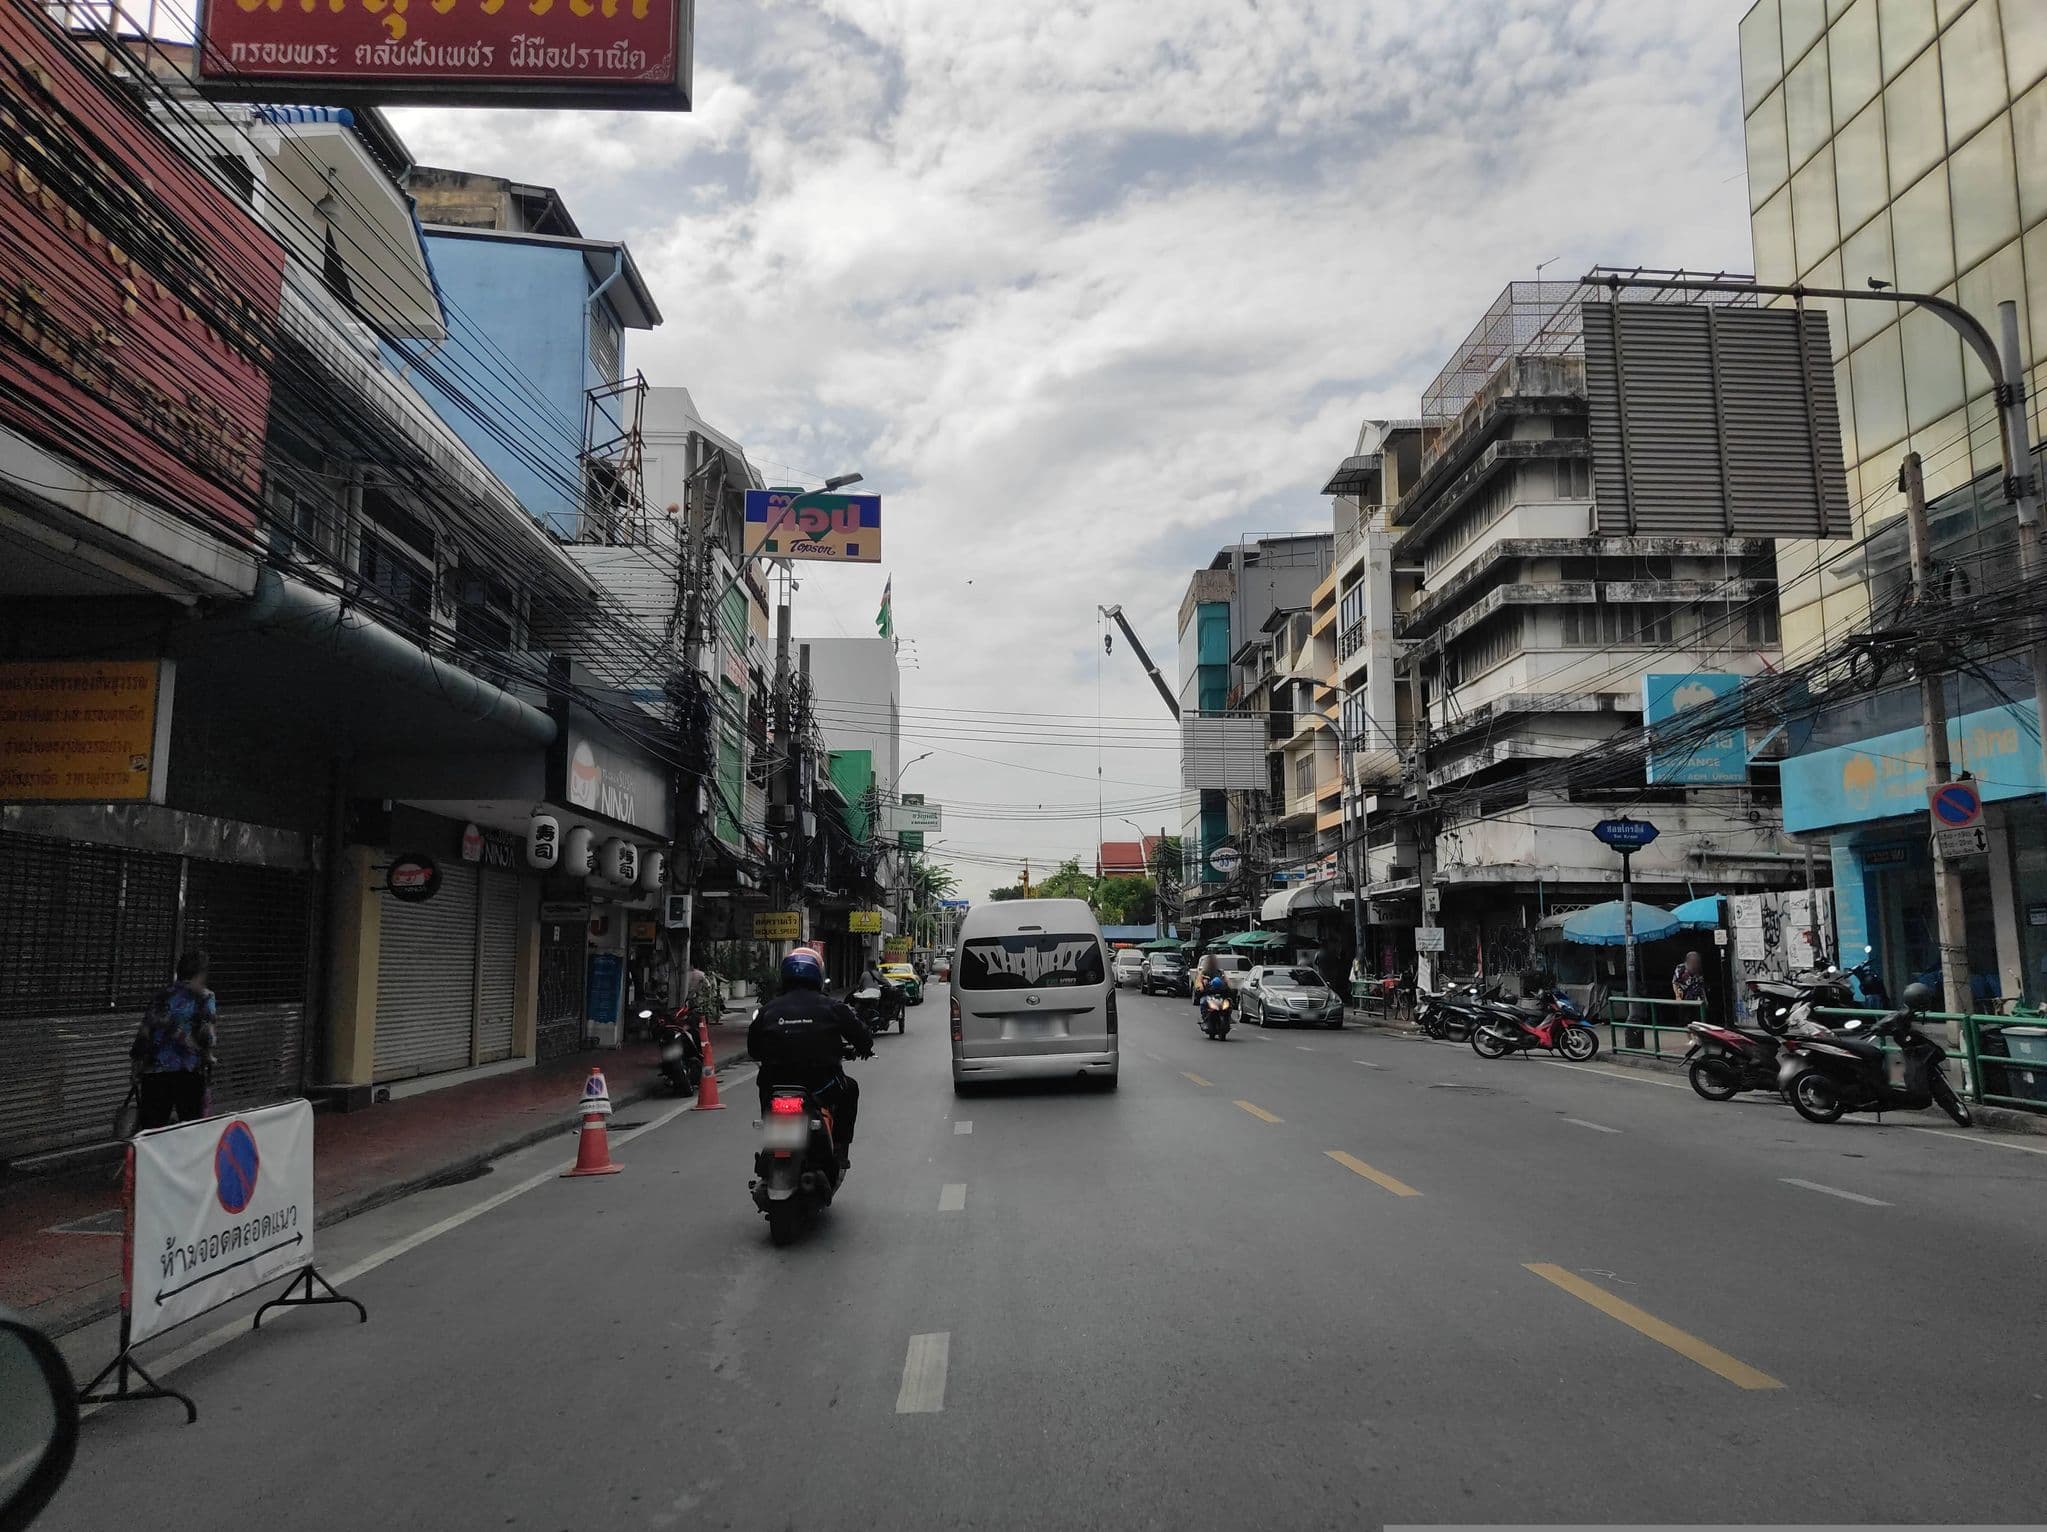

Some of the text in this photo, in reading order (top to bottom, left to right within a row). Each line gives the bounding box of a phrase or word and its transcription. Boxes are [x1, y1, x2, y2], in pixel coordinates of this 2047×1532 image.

[231, 41, 339, 65] กรอบพระ
[354, 37, 496, 68] ตลับฝังเพชร
[789, 538, 836, 556] Topson
[601, 782, 636, 826] NINJA
